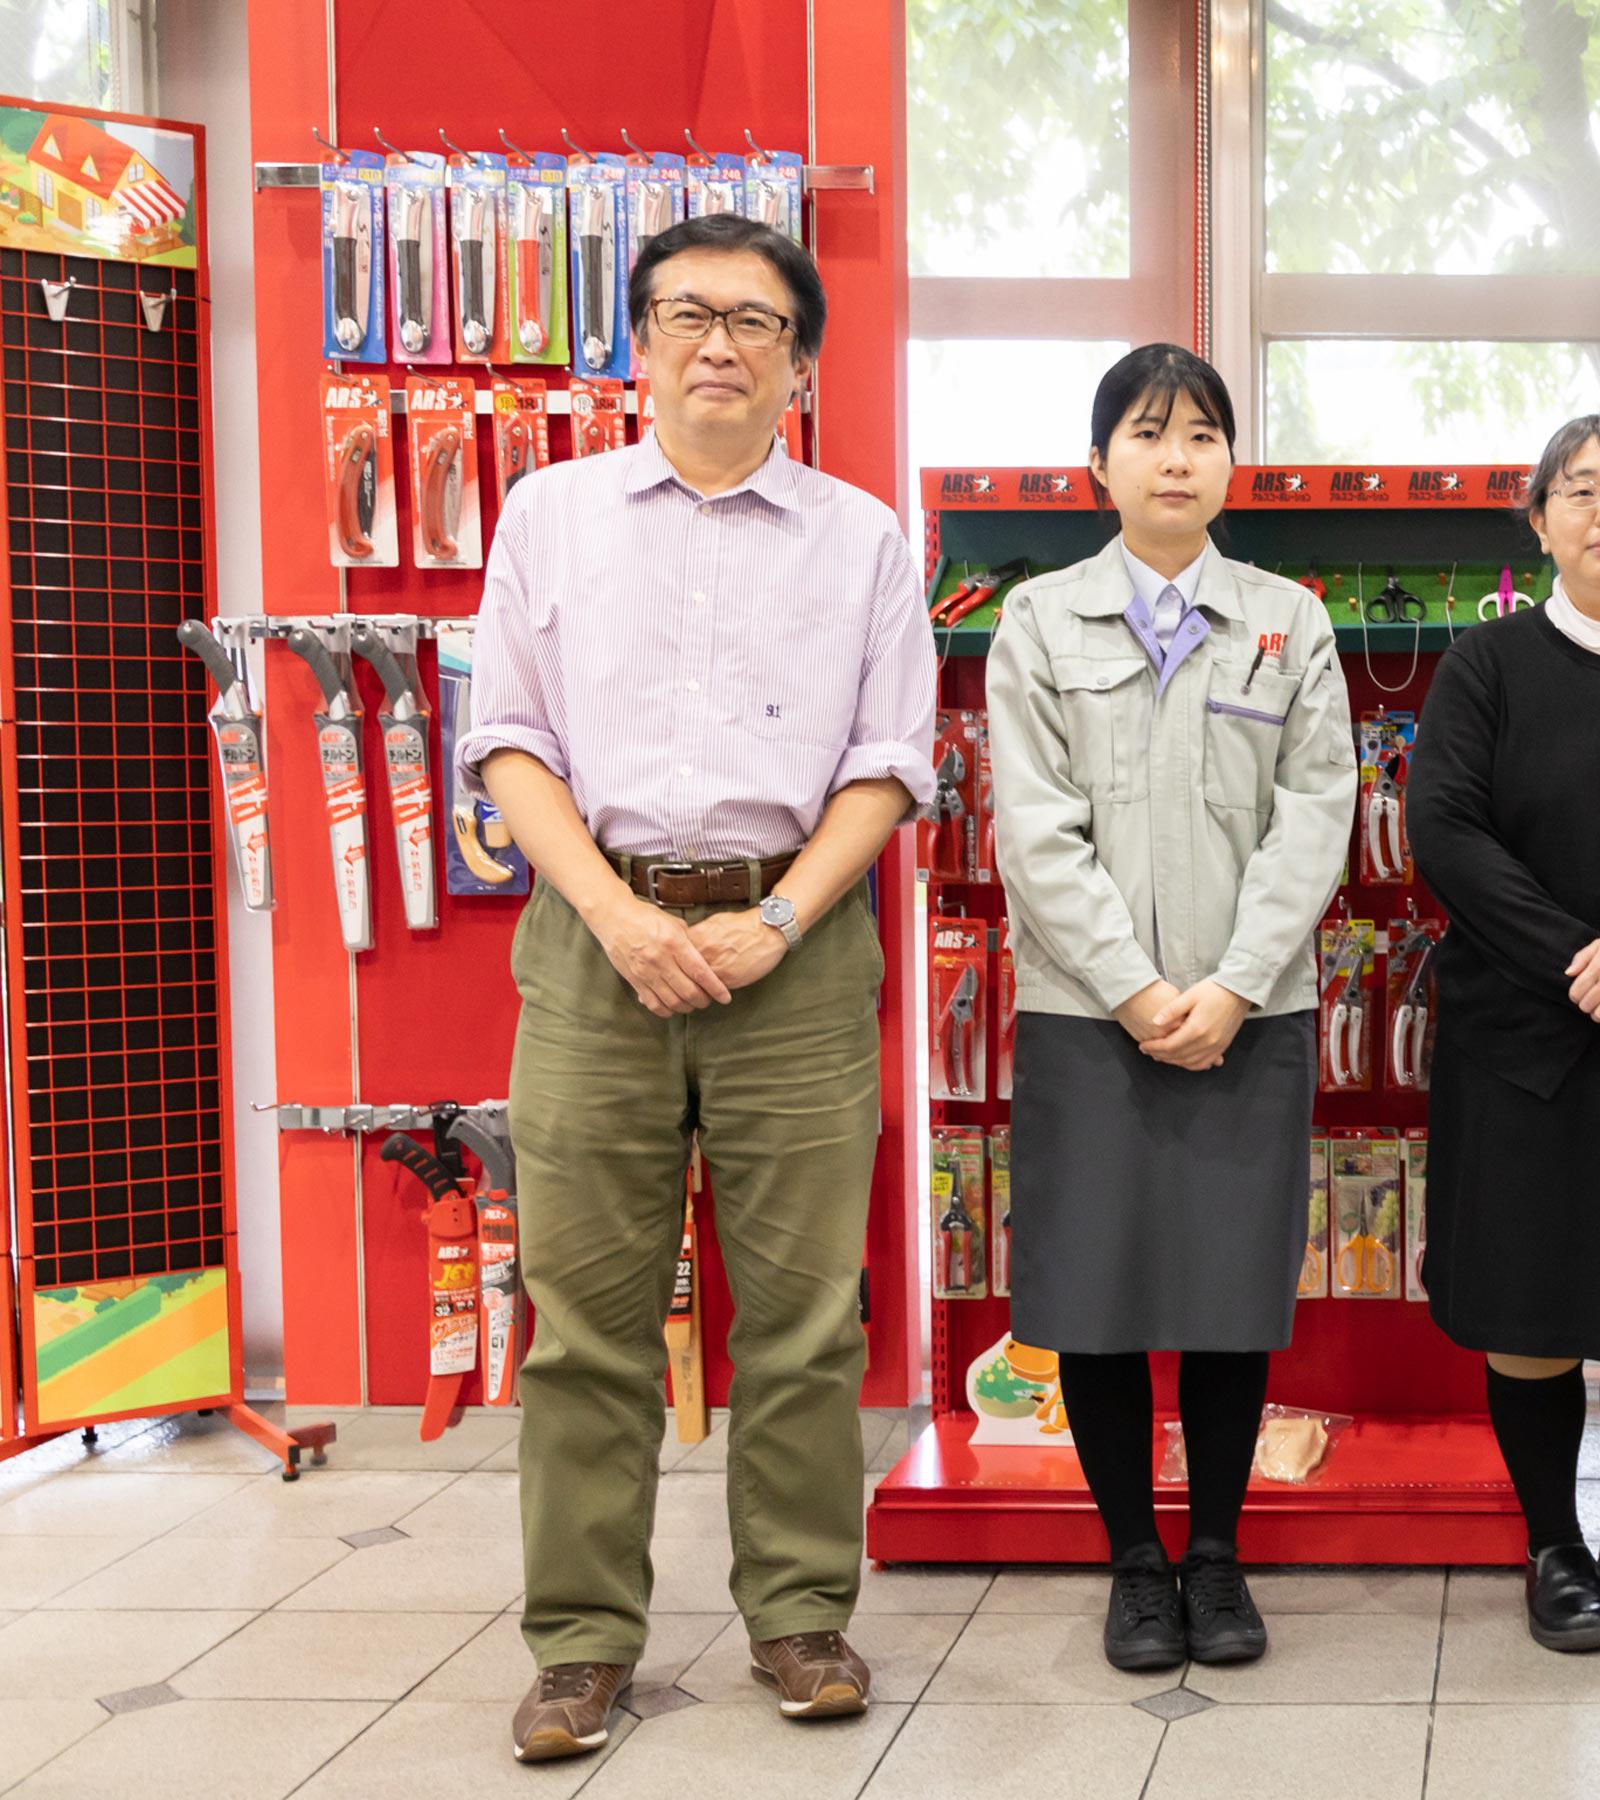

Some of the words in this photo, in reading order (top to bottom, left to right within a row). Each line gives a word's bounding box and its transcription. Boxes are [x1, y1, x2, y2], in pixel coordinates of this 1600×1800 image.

[325, 387, 362, 409] ARS
[411, 388, 447, 411] ARS
[942, 474, 975, 493] ARS
[1019, 474, 1053, 493] ARS
[1252, 472, 1286, 491] ARS
[1330, 472, 1365, 491] ARS
[1408, 471, 1442, 490] ARS
[1487, 471, 1521, 490] ARS
[934, 930, 963, 949] ARS
